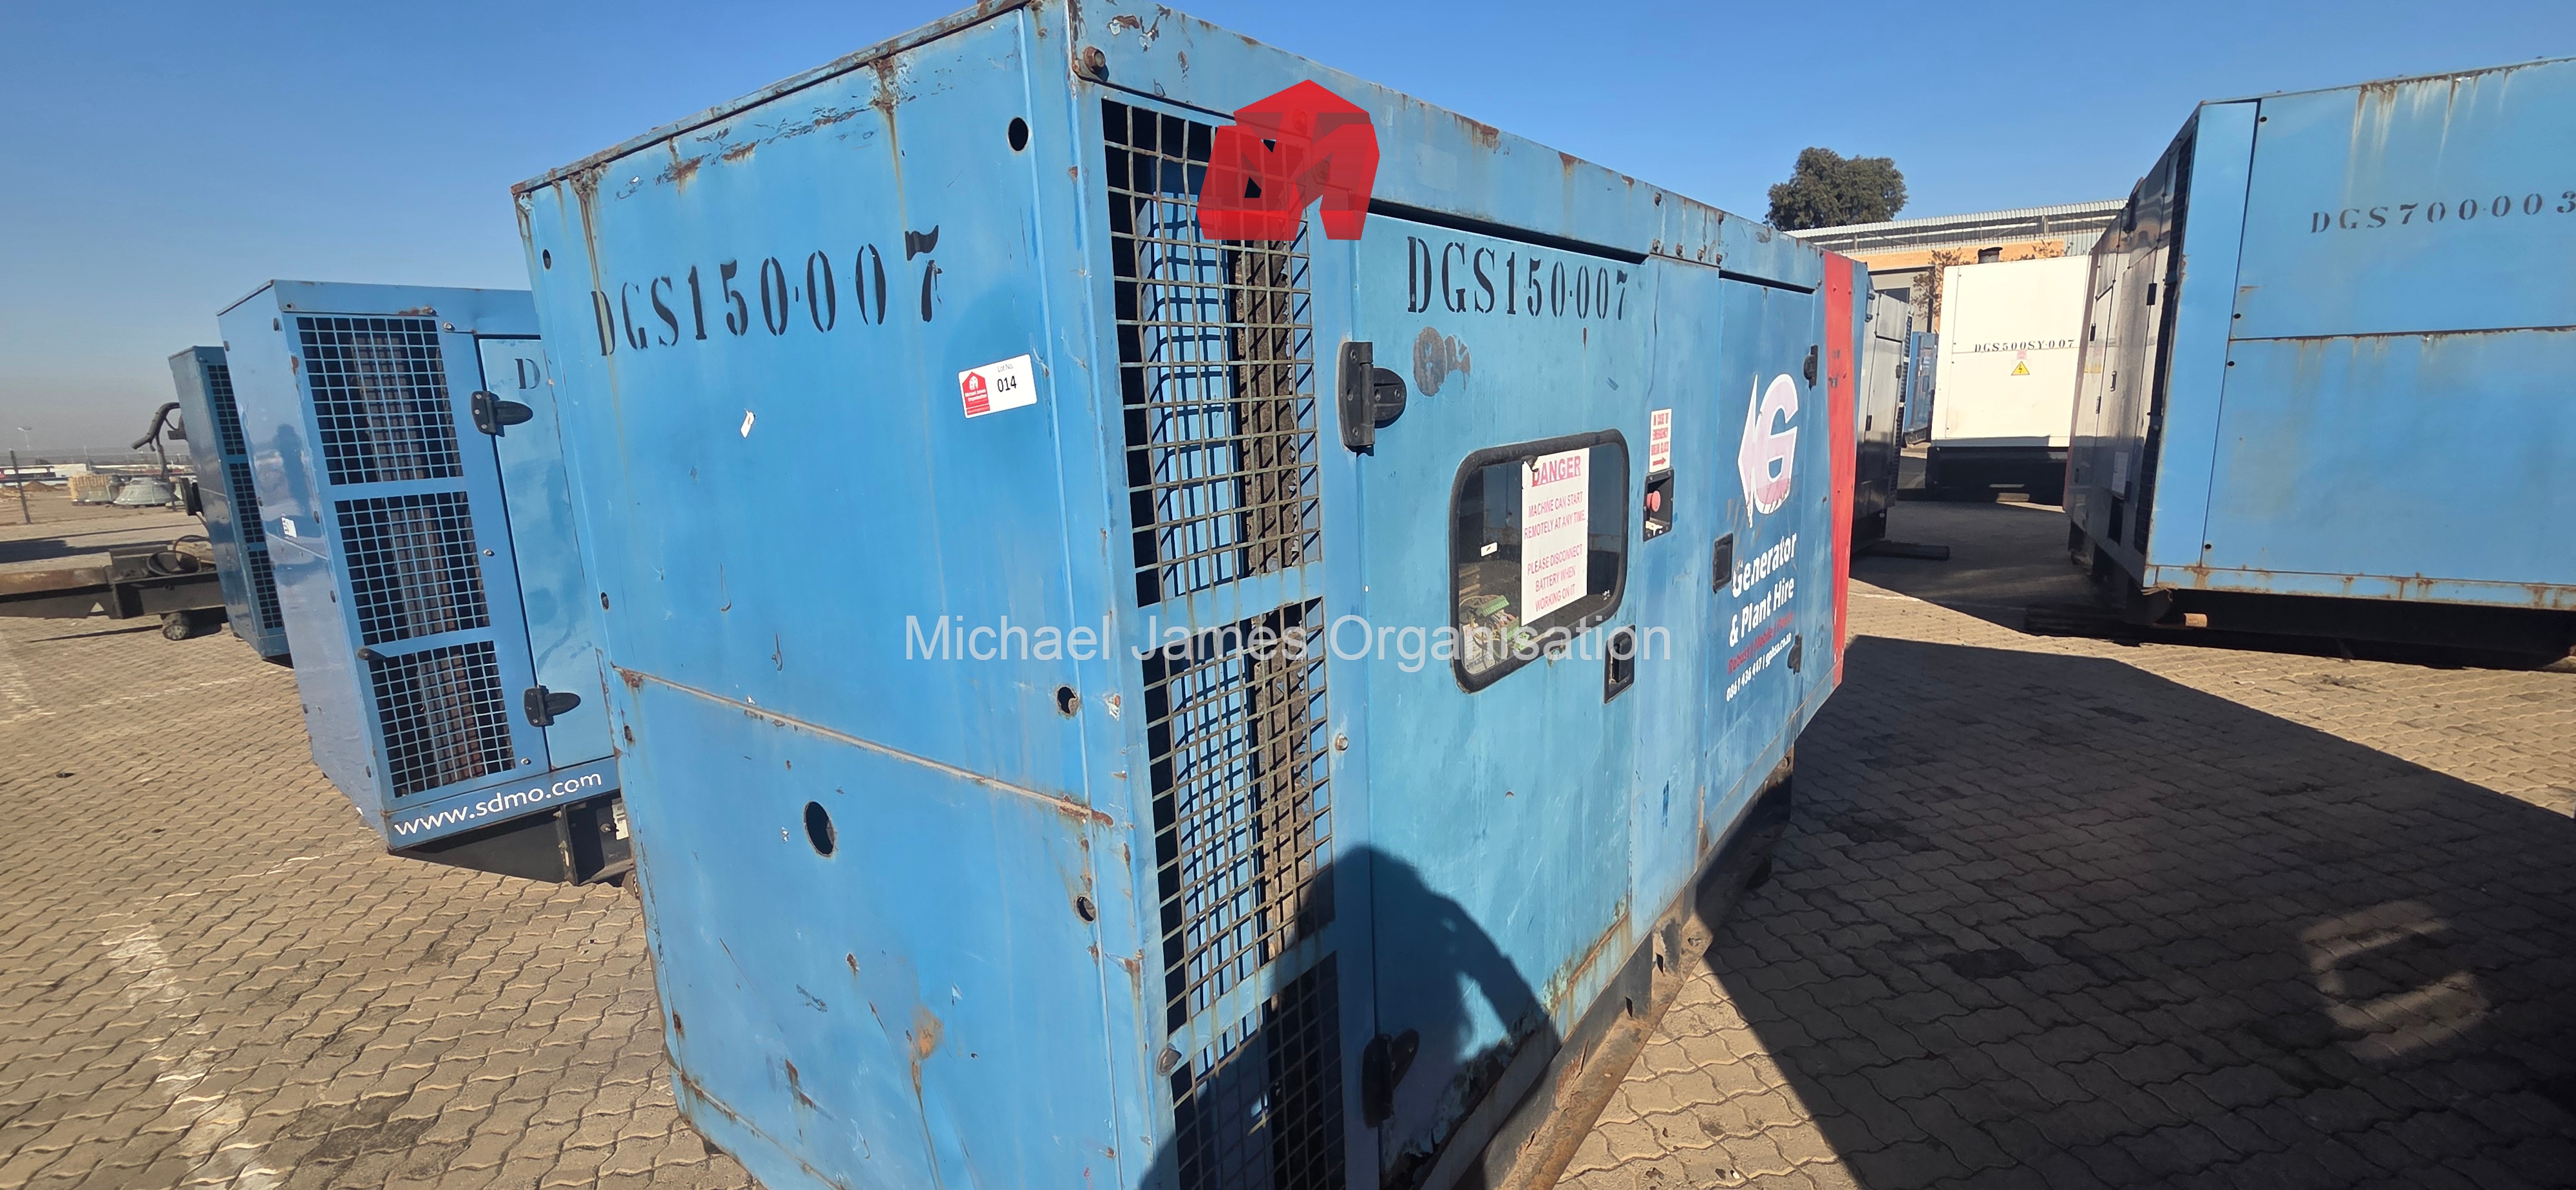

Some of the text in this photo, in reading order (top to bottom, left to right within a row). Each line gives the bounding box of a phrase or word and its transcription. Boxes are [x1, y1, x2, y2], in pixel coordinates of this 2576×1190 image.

[997, 375, 1017, 392] 014
[1532, 455, 1581, 487] DANGER
[1528, 491, 1583, 518] MACHINE CAN START
[1524, 519, 1554, 540] REMOTELY
[1554, 516, 1562, 530] AT
[1562, 513, 1573, 527] ANY
[1528, 543, 1583, 576] PLEASE DISCONNECT
[1732, 533, 1797, 598] Generator
[1535, 572, 1560, 592] BATTERY
[1535, 590, 1562, 612] WORKING
[1562, 586, 1570, 600] ON
[1729, 578, 1794, 647] & Plant Hire
[394, 773, 601, 836] www.sdmo.com
